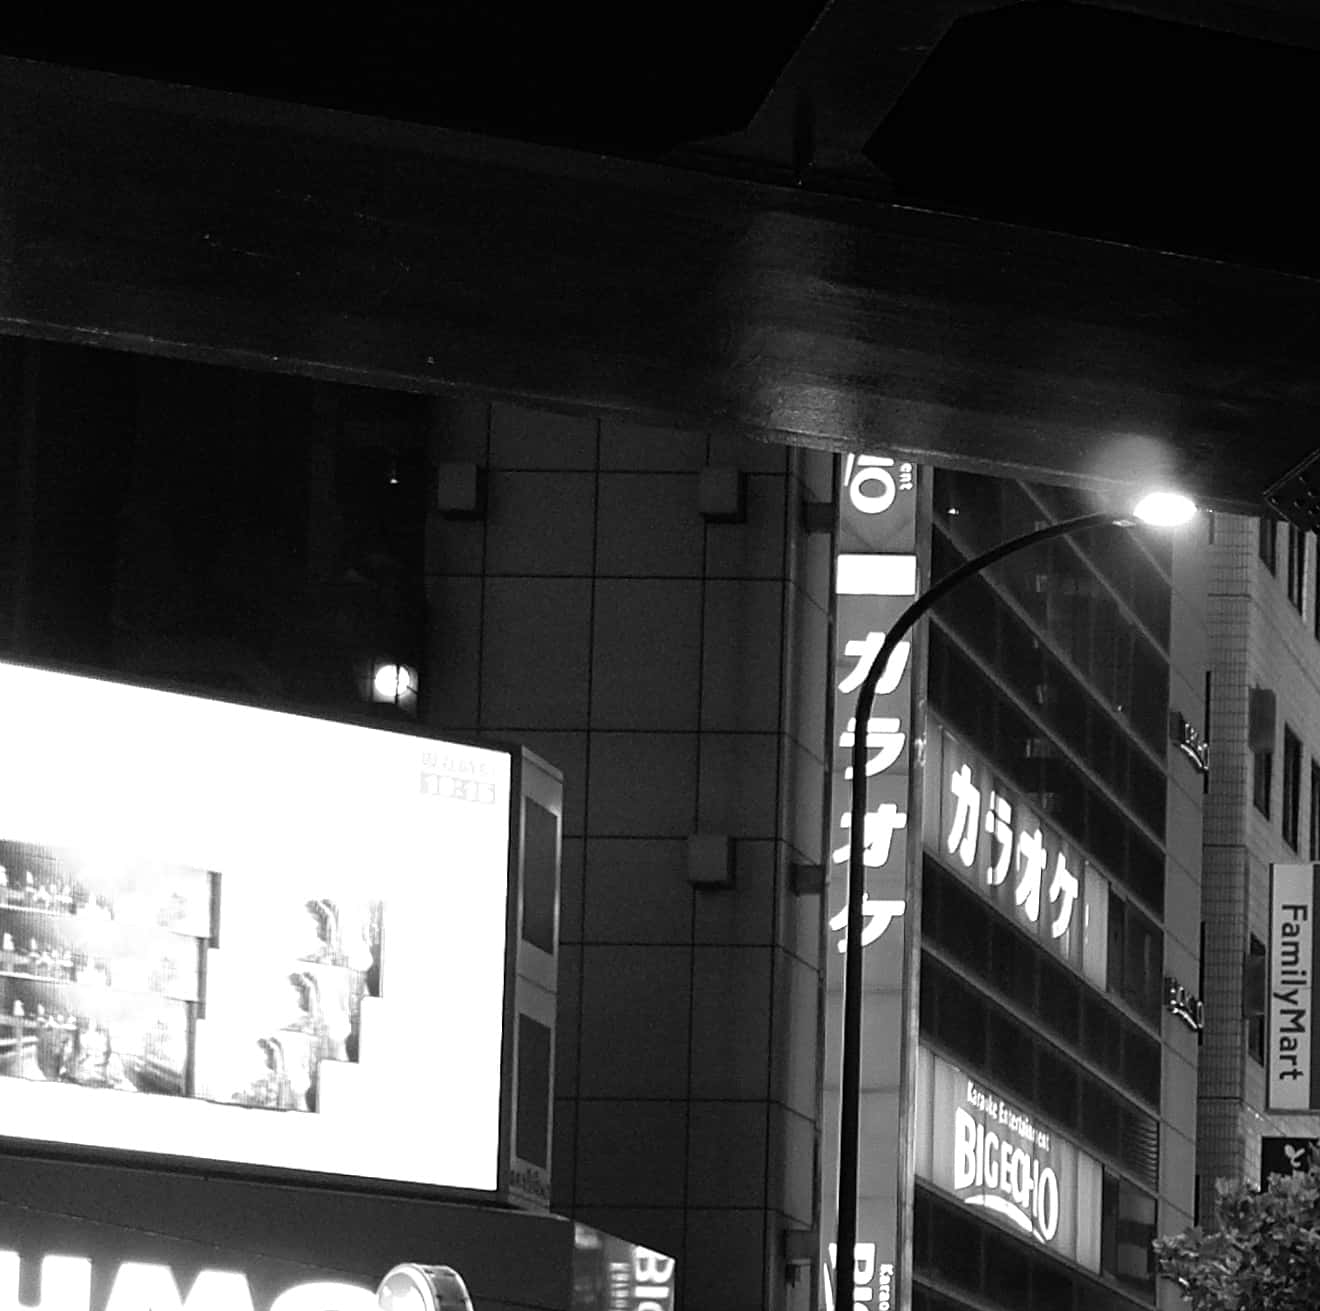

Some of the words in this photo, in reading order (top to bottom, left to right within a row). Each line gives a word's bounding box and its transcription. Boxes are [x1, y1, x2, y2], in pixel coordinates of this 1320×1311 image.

[947, 764, 1079, 939] カラオケ
[1273, 902, 1308, 1081] FamilyMart
